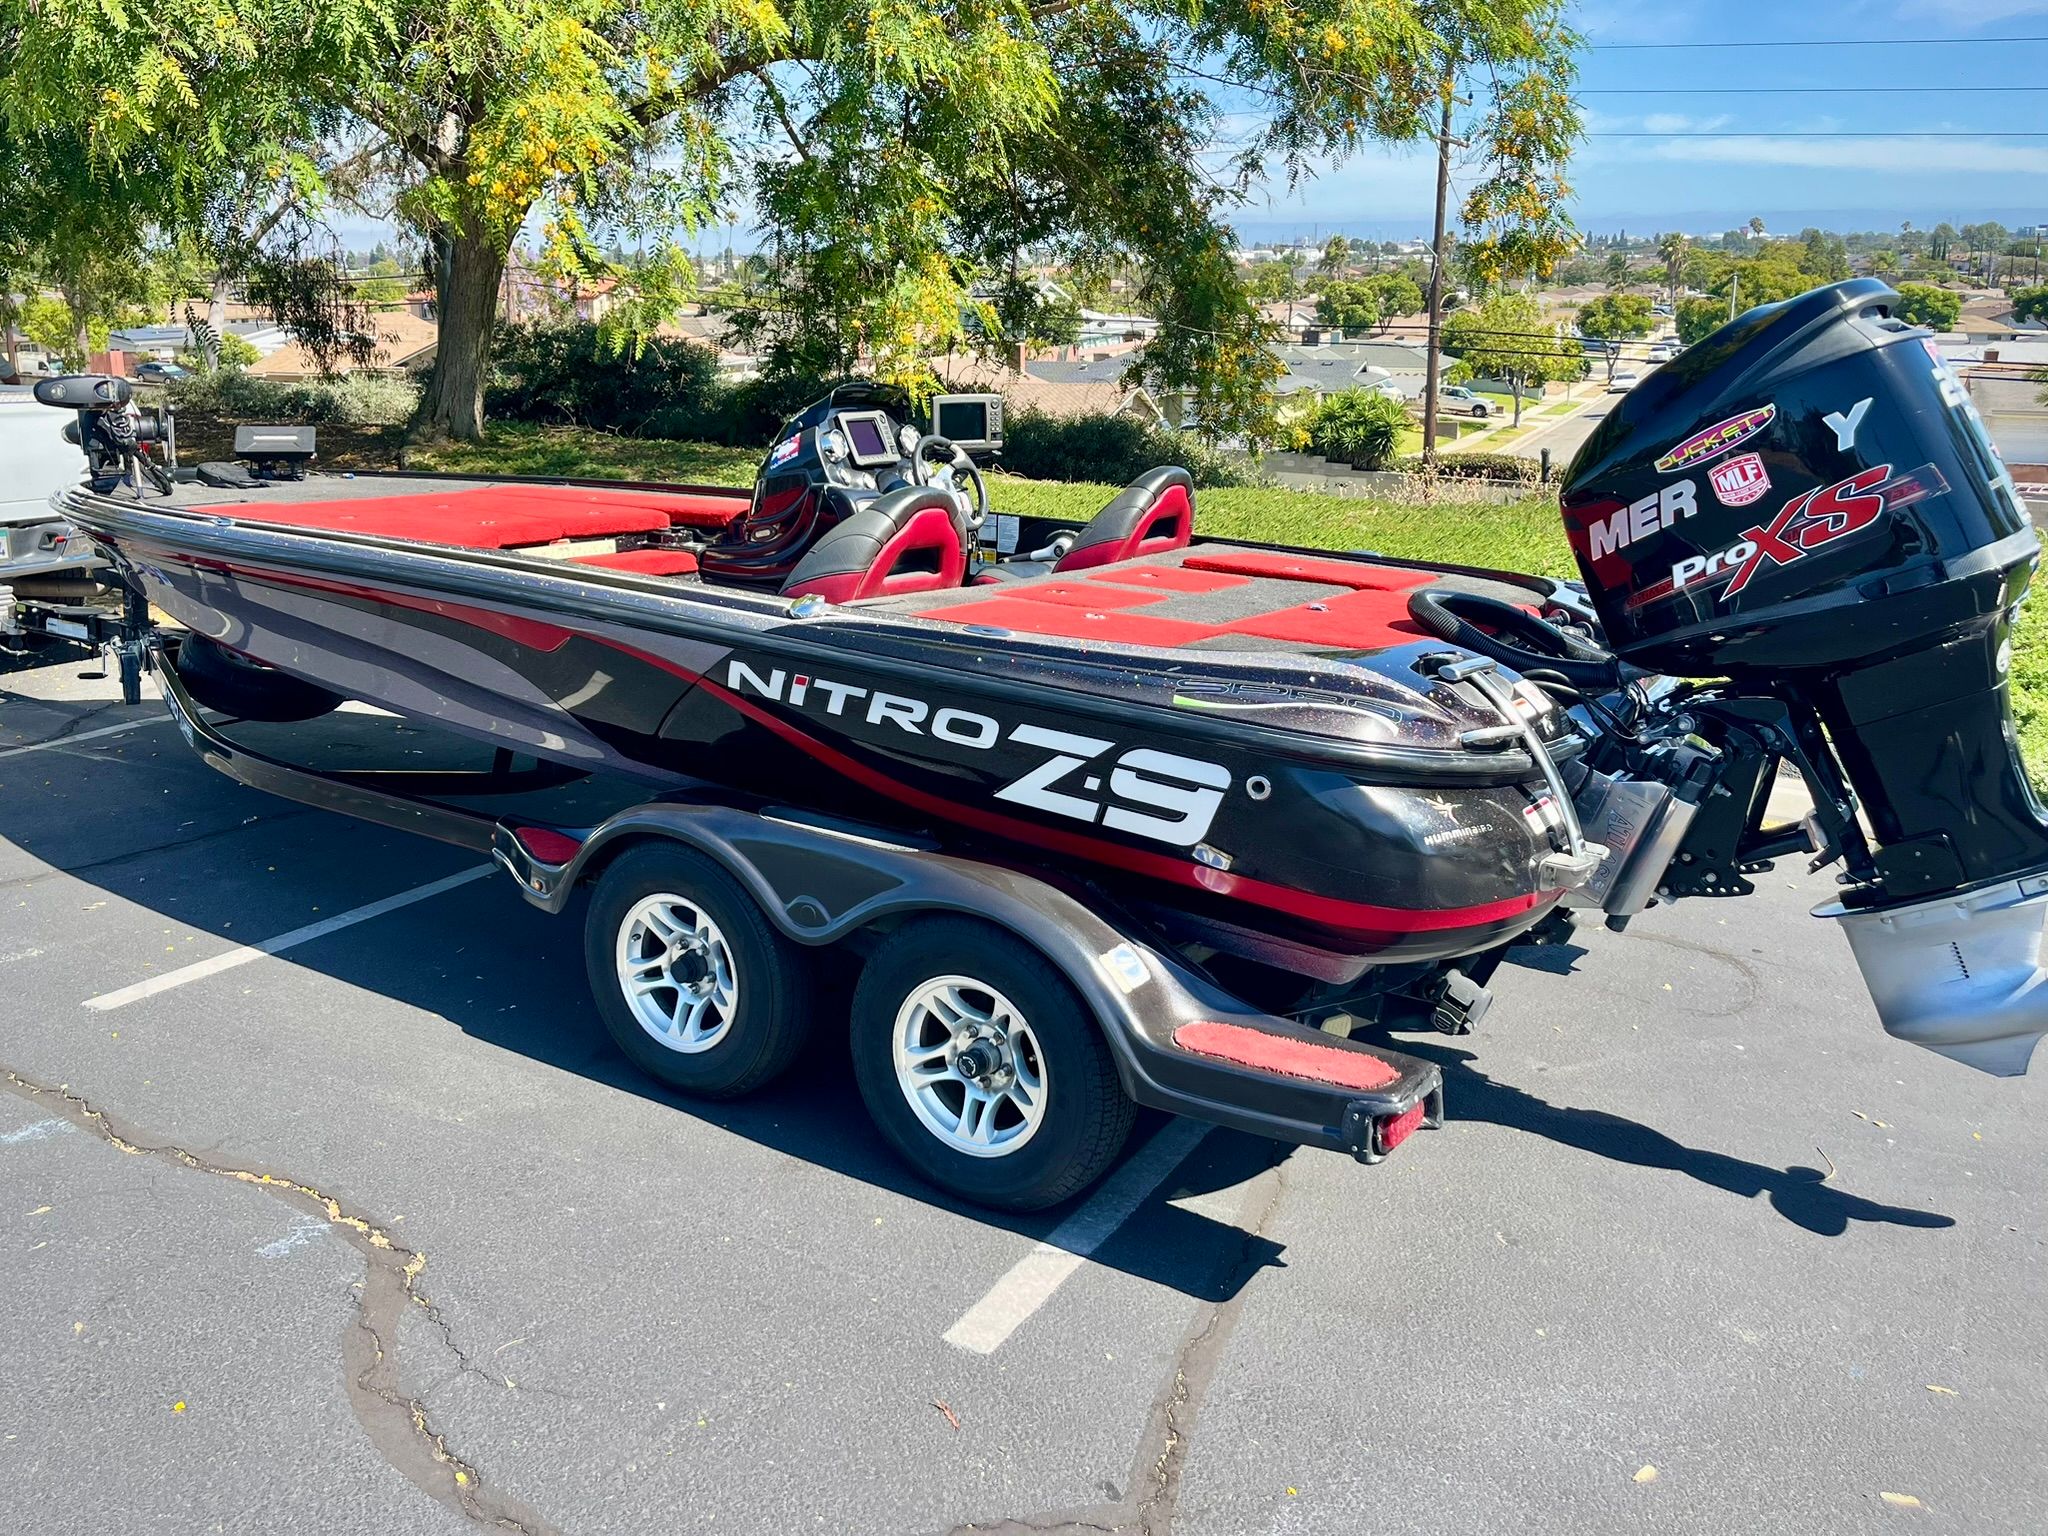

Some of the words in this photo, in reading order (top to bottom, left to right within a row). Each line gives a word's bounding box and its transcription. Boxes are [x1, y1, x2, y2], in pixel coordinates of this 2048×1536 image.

[1654, 403, 1776, 471] DUCKETT
[1717, 463, 1762, 493] MLF
[1589, 479, 1698, 560] MER
[727, 660, 1000, 750] NITRO
